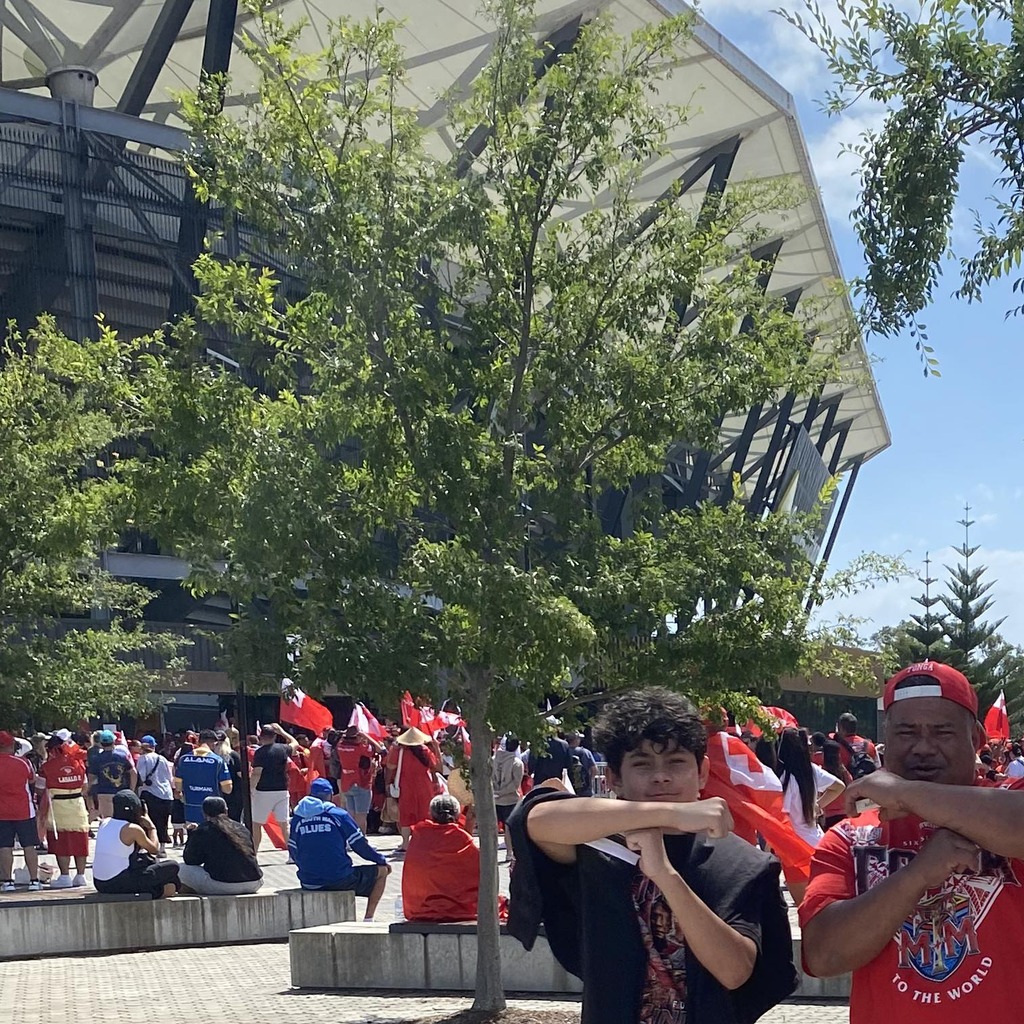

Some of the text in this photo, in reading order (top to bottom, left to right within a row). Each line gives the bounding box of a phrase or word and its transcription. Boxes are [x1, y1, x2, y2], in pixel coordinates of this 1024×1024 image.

[907, 662, 934, 673] TONGA
[183, 756, 216, 764] ALAND
[299, 823, 332, 835] BLUES
[892, 956, 993, 1003] TO THE WORLD
